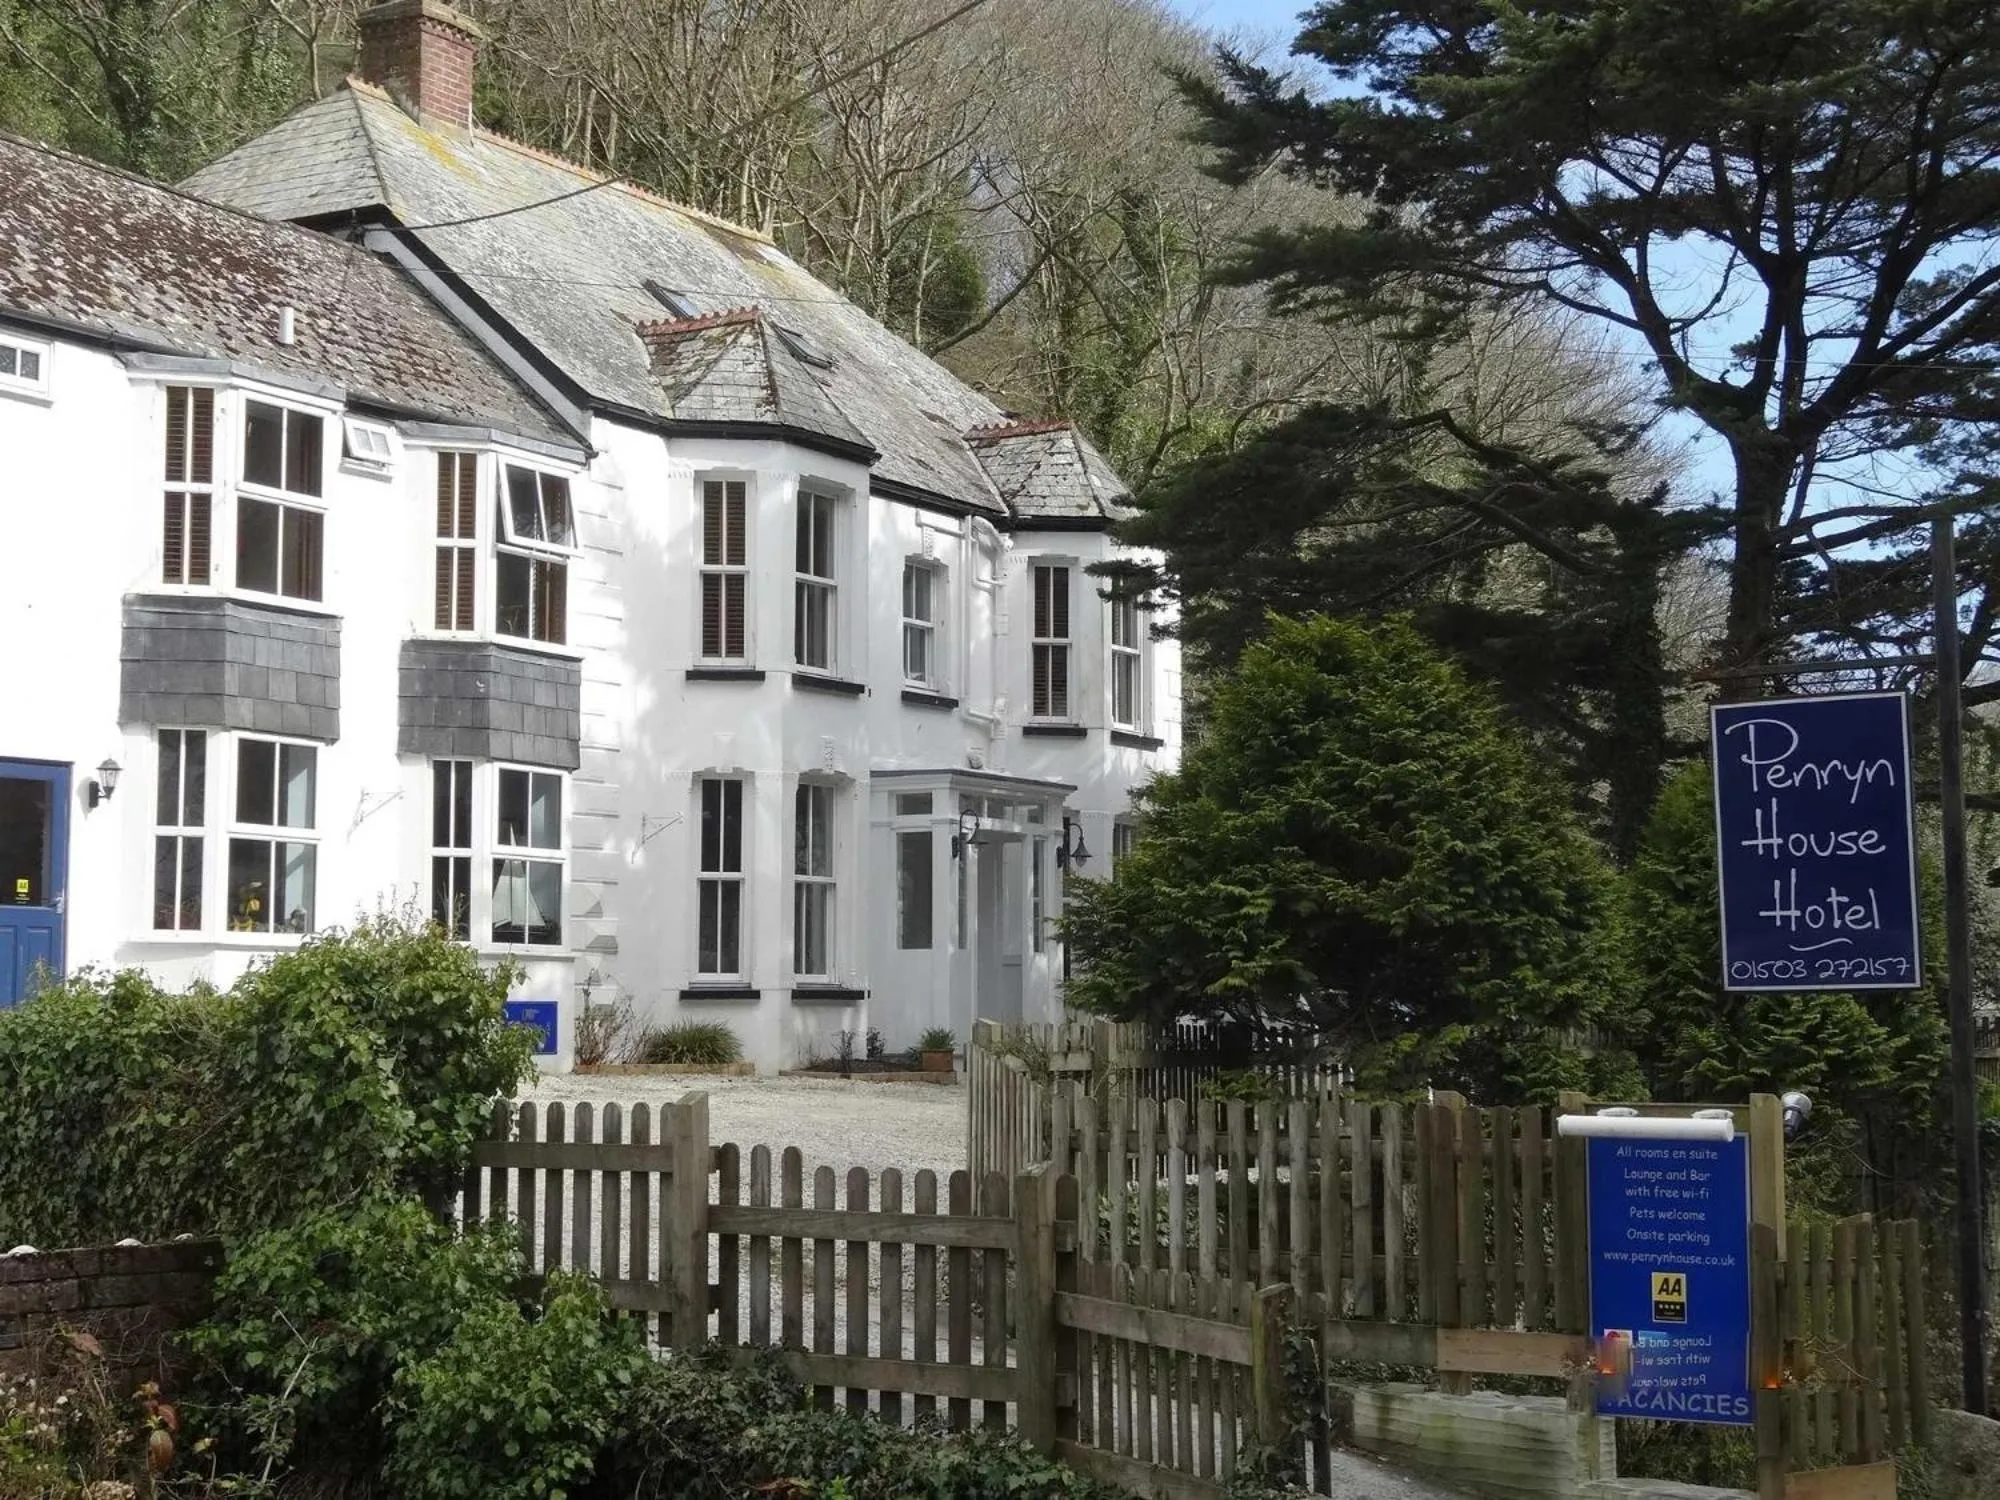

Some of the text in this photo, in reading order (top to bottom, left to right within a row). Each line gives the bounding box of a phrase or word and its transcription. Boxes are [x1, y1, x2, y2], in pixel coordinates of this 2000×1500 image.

[1724, 718, 1895, 804] Penryn
[1741, 797, 1886, 860] House
[1759, 867, 1880, 932] Hotel
[1731, 957, 1911, 979] 01503 272157
[1616, 1146, 1719, 1160] All rooms en suite
[1624, 1167, 1711, 1182] Lounge and Bar
[1625, 1185, 1709, 1199] with free wi-fi
[1630, 1206, 1706, 1221] Pets welcome
[1626, 1228, 1711, 1246] Onsite parking
[1603, 1250, 1736, 1267] www.penrynhouse.co.uk
[1657, 1276, 1682, 1297] AA
[1608, 1389, 1750, 1416] ACANCIES
